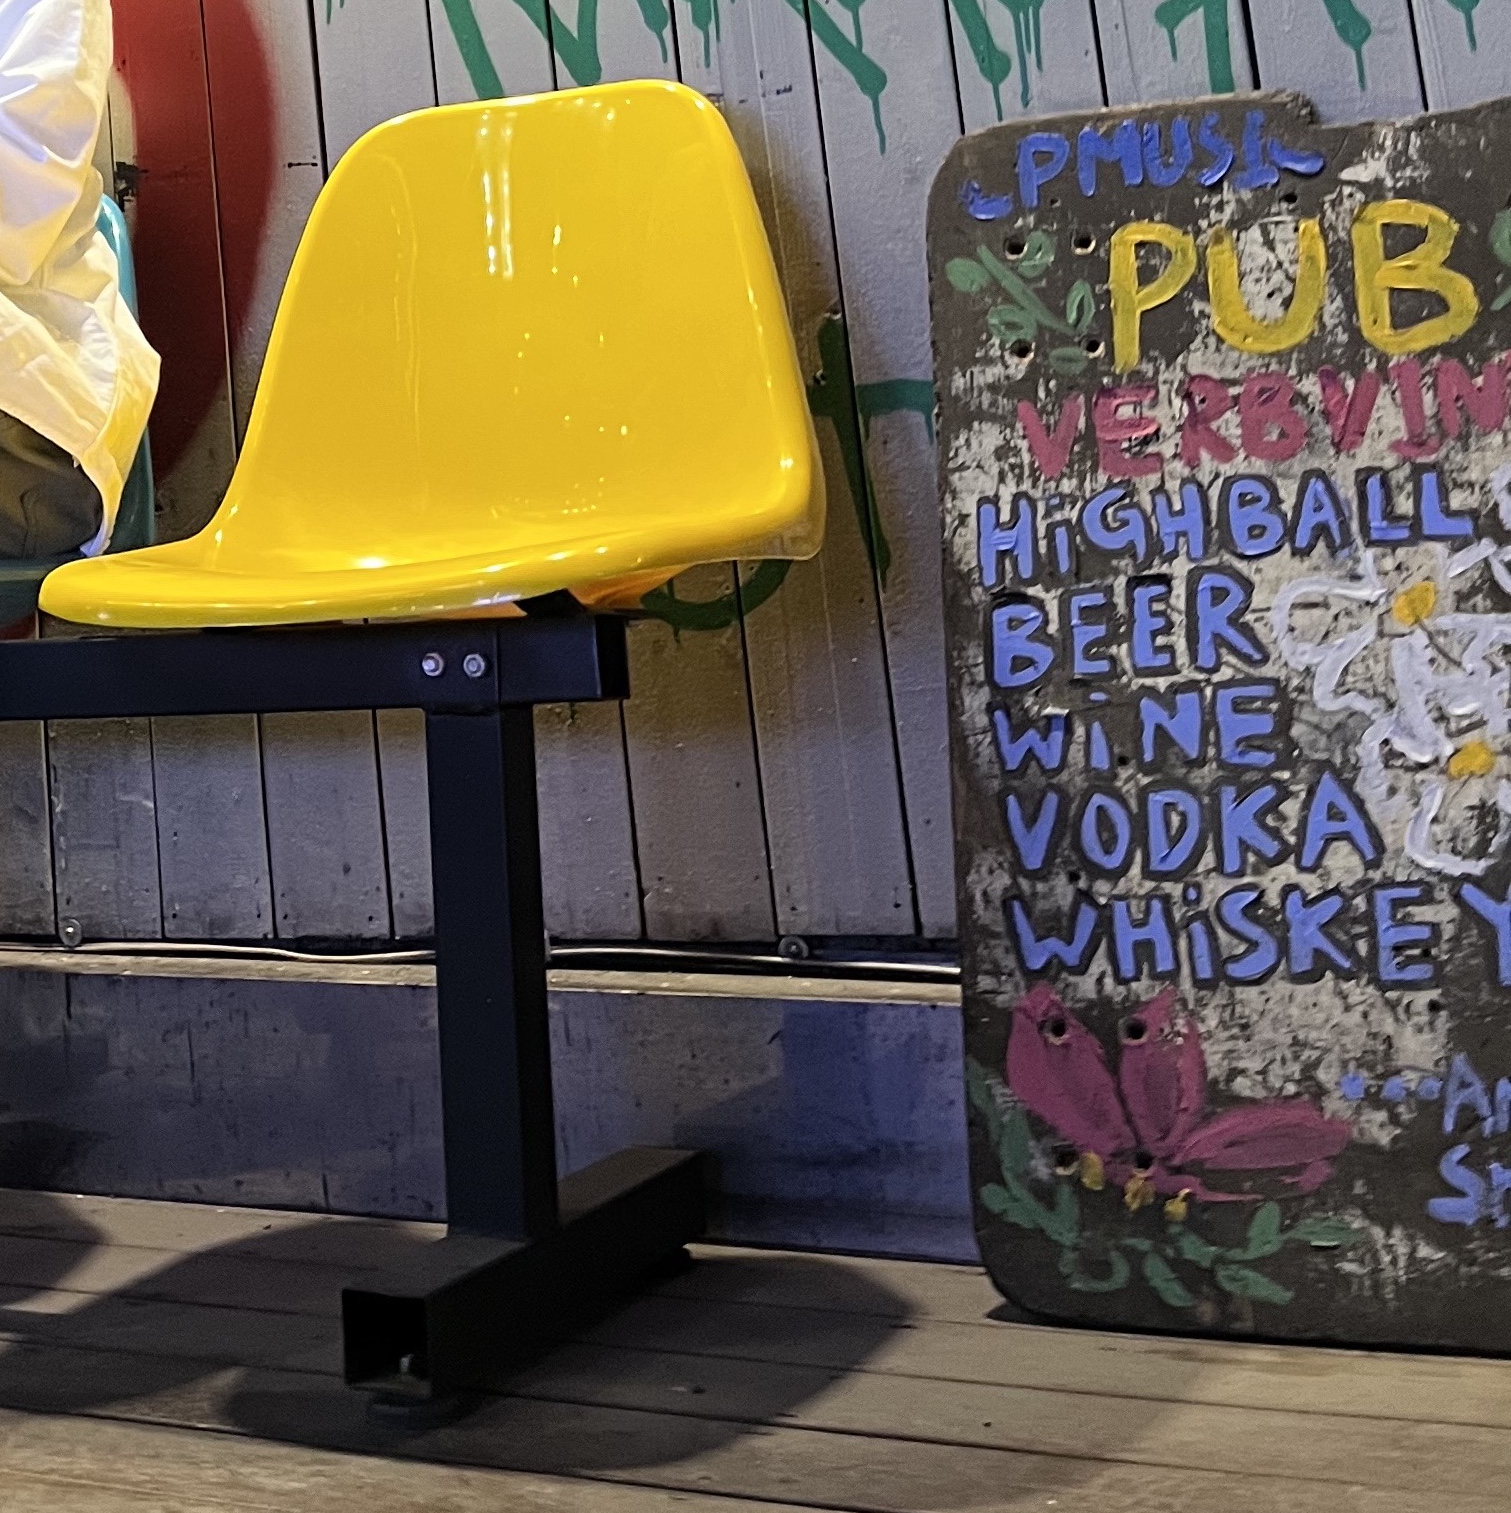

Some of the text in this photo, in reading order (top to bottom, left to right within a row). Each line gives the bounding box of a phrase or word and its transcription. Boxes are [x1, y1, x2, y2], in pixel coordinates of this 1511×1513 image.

[1108, 198, 1480, 375] PUB
[989, 566, 1268, 688] BEER
[1005, 771, 1383, 874] VODKA
